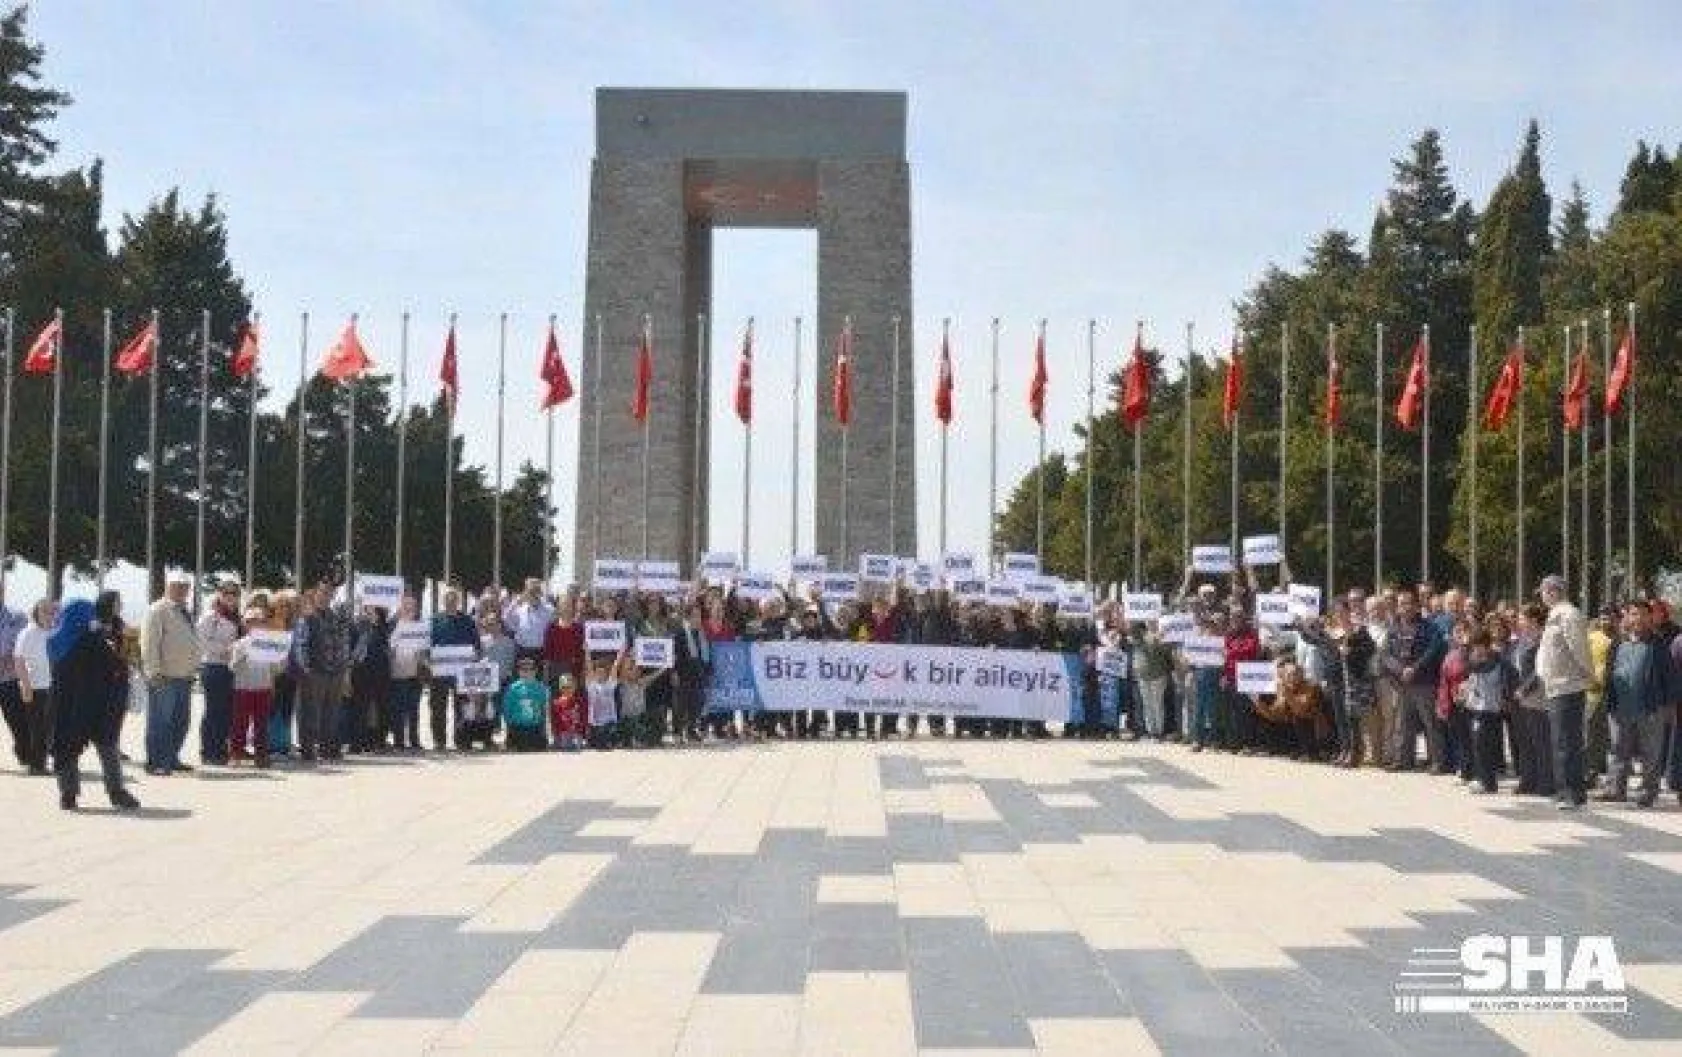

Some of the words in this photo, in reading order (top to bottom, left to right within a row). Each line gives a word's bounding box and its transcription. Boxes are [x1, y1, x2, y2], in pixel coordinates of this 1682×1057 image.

[765, 655, 807, 680] Biz
[818, 655, 917, 685] büyk
[929, 660, 966, 684] bir
[974, 664, 1062, 692] aileyiz
